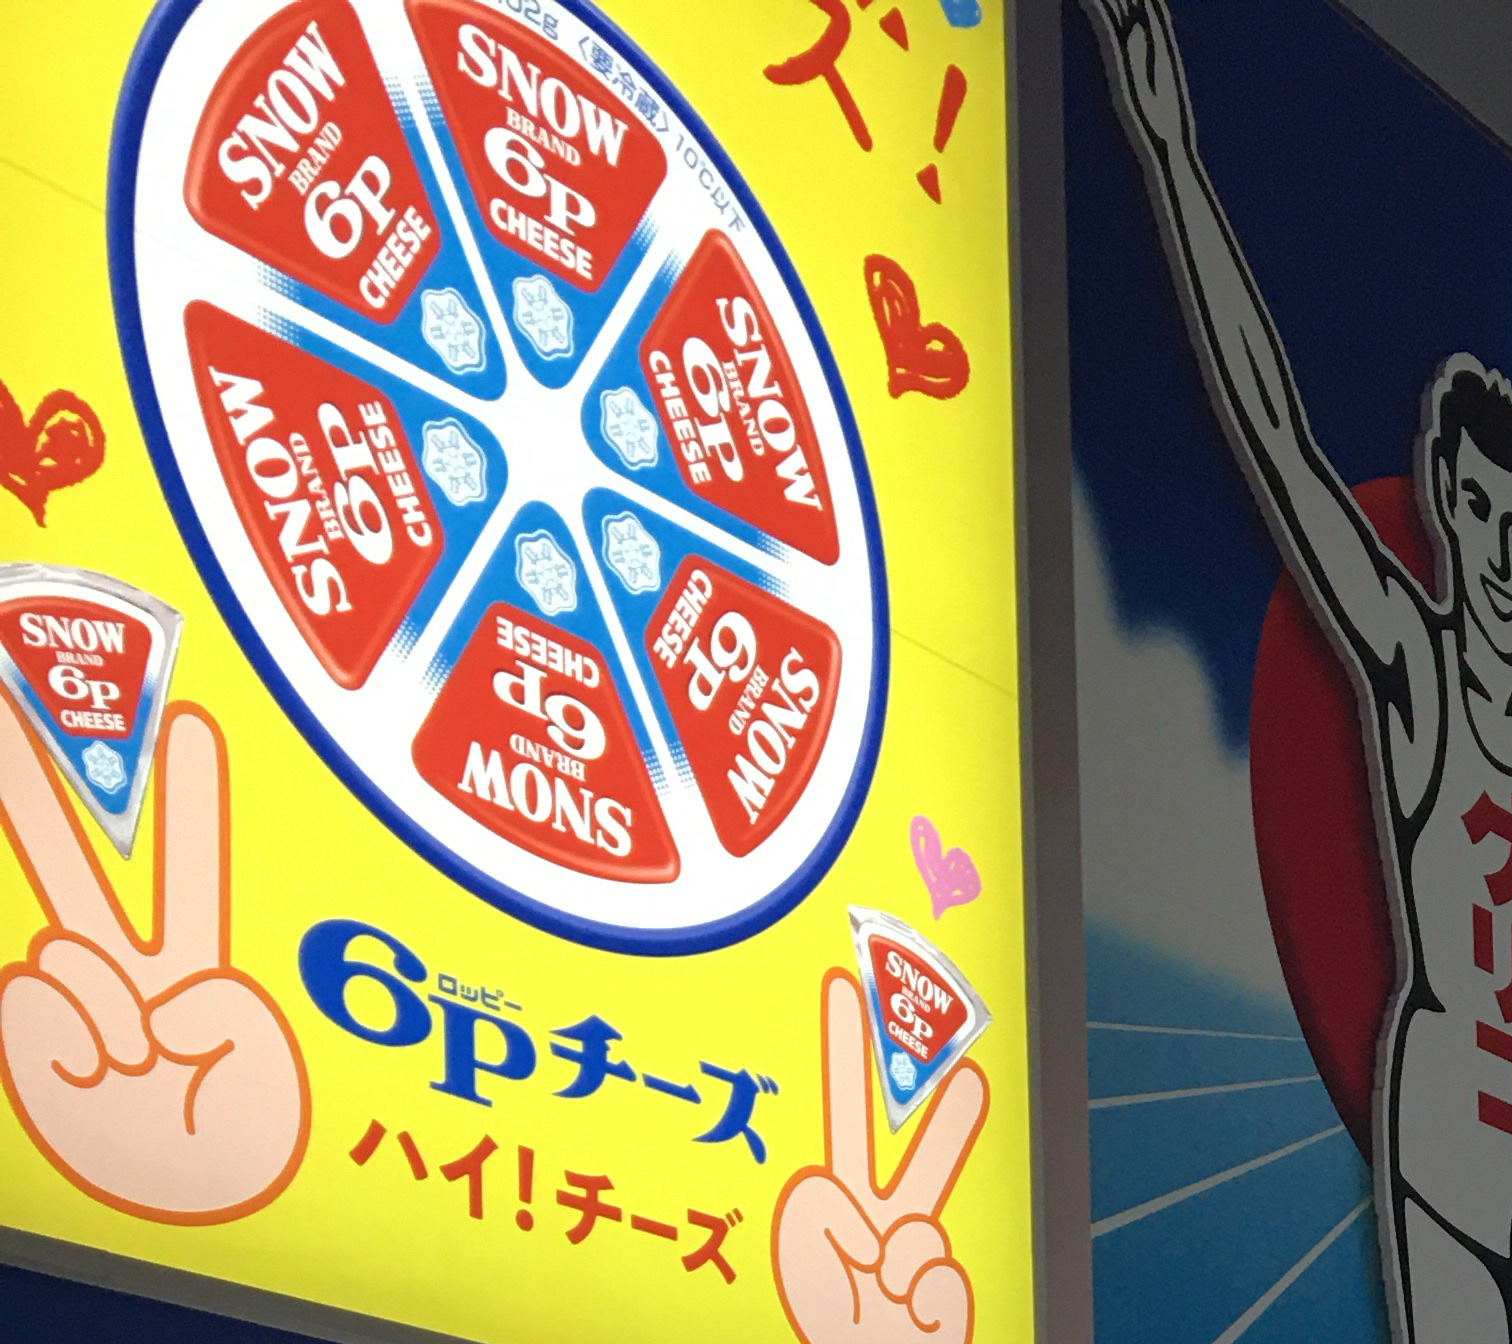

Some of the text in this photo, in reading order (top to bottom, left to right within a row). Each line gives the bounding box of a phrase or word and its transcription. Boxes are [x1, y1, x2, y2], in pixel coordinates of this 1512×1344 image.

[218, 20, 345, 210] SNOW
[457, 23, 629, 167] SNOW
[506, 106, 581, 167] BRAND
[289, 121, 343, 195] BRAND
[359, 206, 431, 308] CHEESE
[490, 198, 593, 280] CHEESE
[650, 350, 712, 484] CHEESE
[716, 296, 823, 511] SNOW
[723, 361, 766, 456] BRAND
[209, 365, 354, 616] SNOW
[289, 433, 344, 540] BRAND
[358, 401, 432, 546] CHEESE
[20, 613, 125, 653] SNOW
[57, 651, 103, 667] BRAND
[496, 616, 600, 688] CHEESE
[654, 570, 713, 669] CHEESE
[61, 710, 126, 731] CHEESE
[727, 646, 820, 825] SNOW
[729, 664, 768, 735] BRAND
[458, 741, 632, 857] SNOW
[511, 734, 586, 782] BRAND
[886, 951, 953, 1014] SNOW
[902, 986, 931, 1013] BRAND
[888, 1021, 929, 1060] CHEESE
